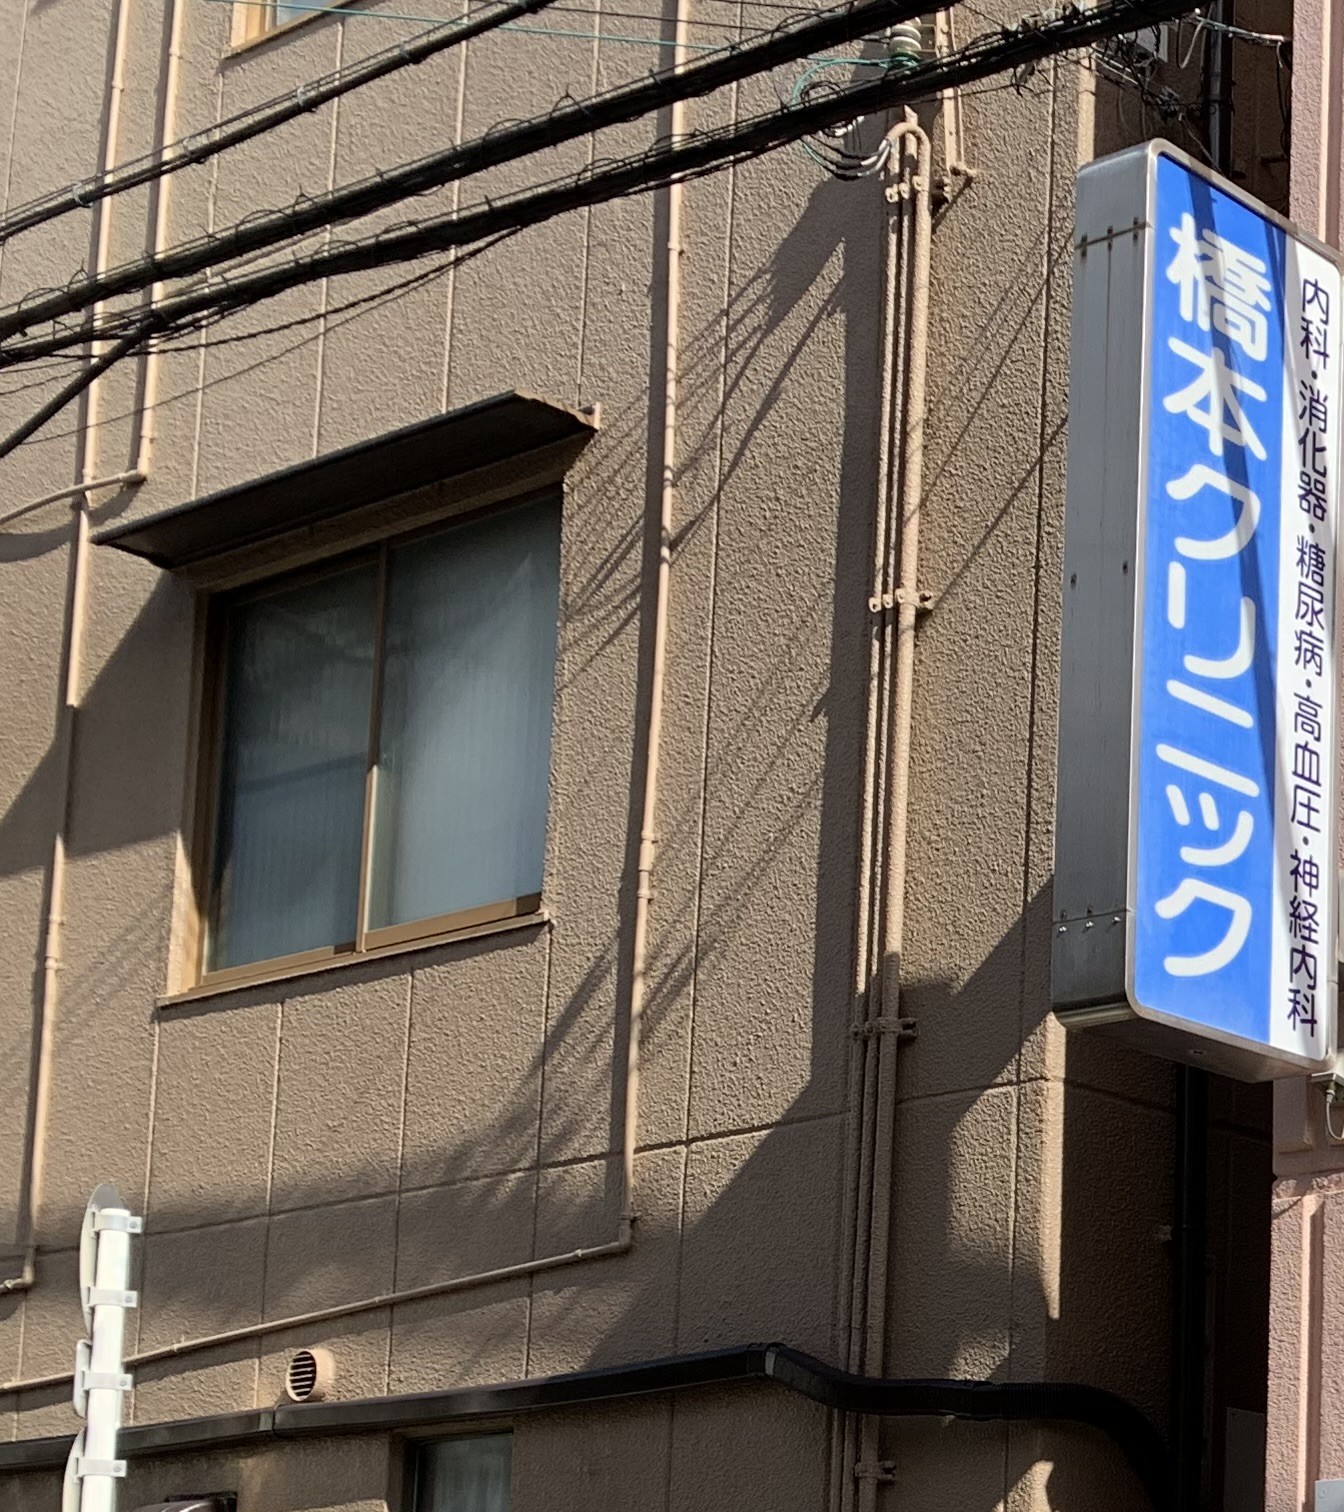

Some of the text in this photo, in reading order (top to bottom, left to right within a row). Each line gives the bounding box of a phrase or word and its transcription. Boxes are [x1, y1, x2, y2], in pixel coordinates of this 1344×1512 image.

[1153, 211, 1272, 978] 橋本クリニック
[1287, 277, 1332, 1038] 内科・消化器・糖尿病・高血圧・神経内科
